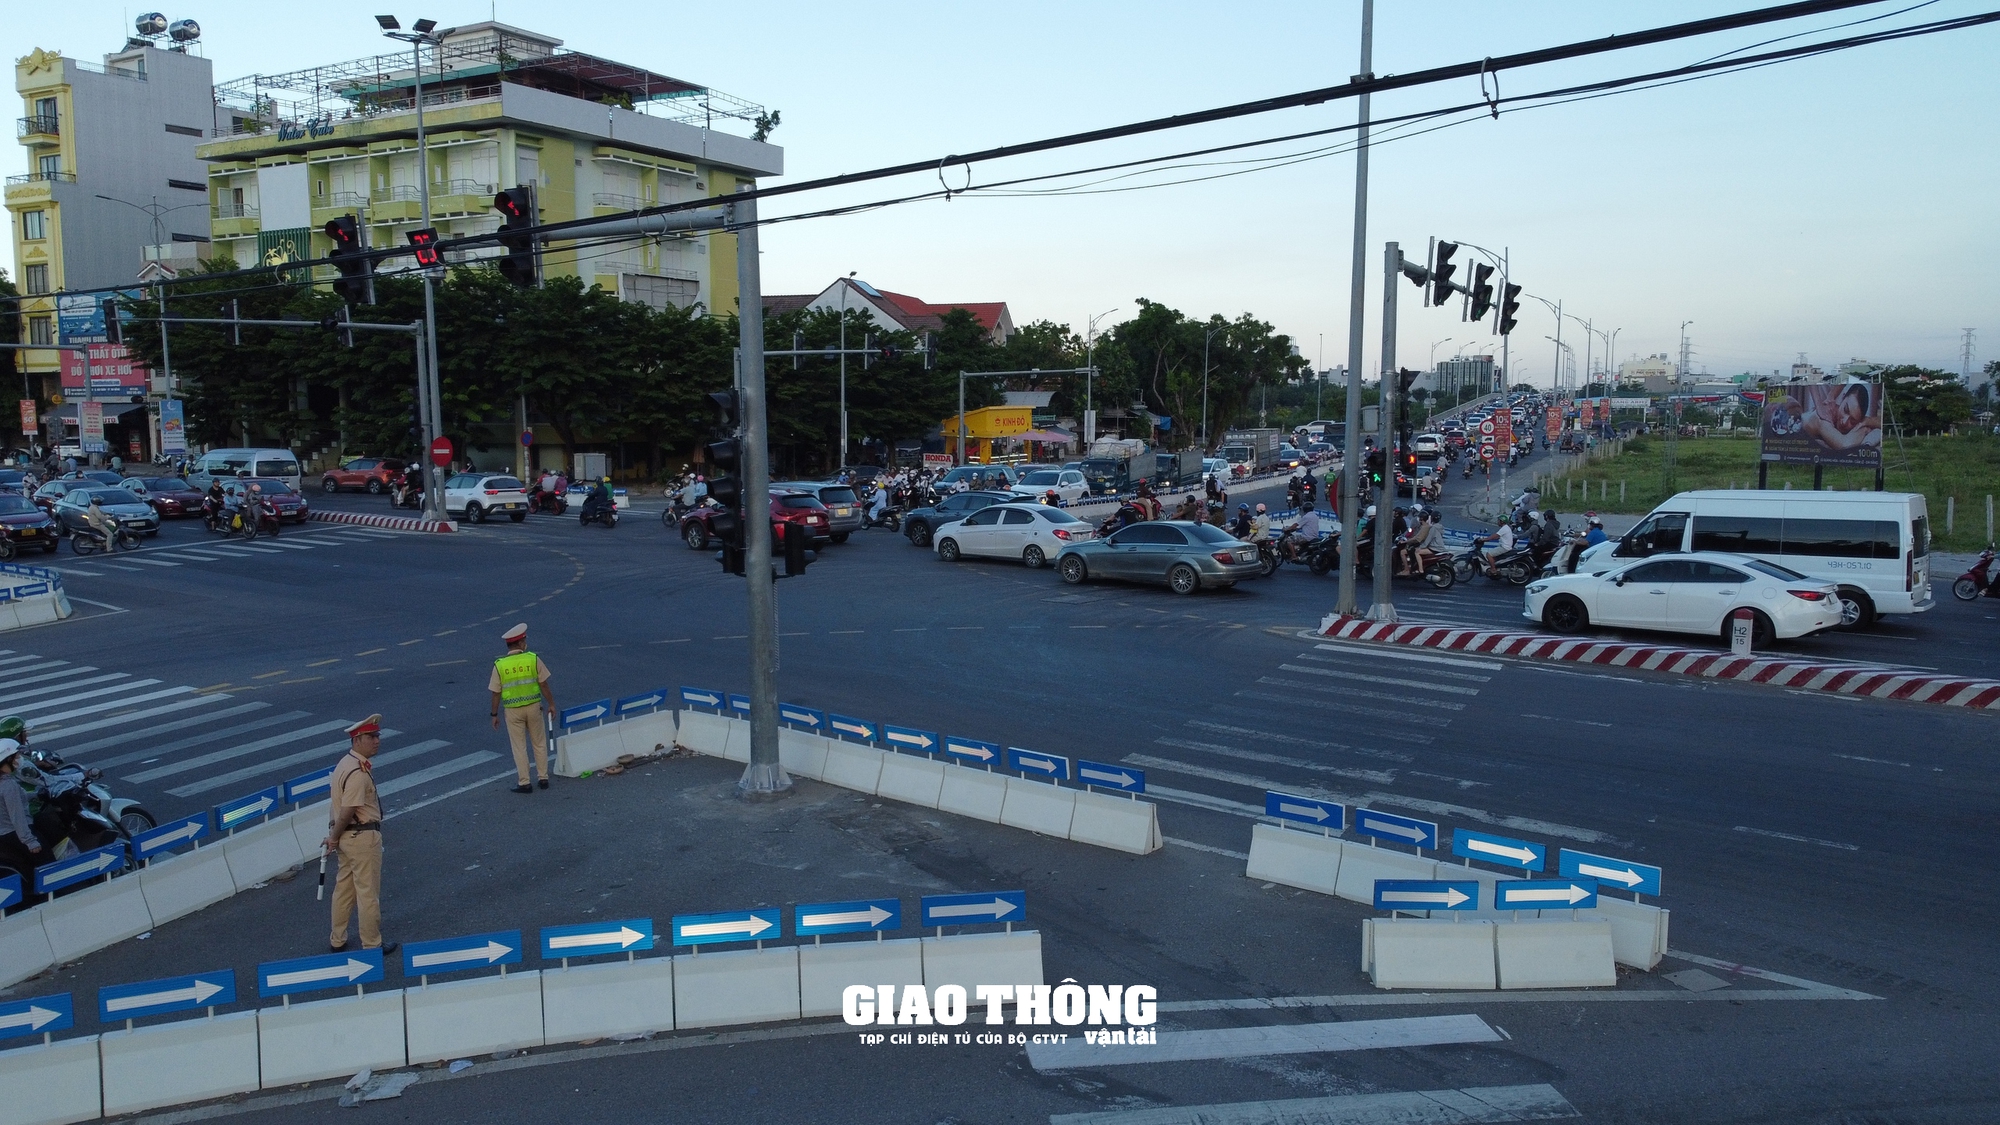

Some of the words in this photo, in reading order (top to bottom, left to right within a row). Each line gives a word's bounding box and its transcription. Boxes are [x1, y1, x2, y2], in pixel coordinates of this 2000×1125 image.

[278, 121, 306, 142] Water
[307, 118, 335, 140] Cube
[105, 365, 115, 375] XE
[1002, 417, 1017, 427] KINH
[1484, 422, 1492, 432] 40
[925, 454, 951, 463] HONDA
[1858, 449, 1878, 458] 100m
[1734, 627, 1748, 636] H2
